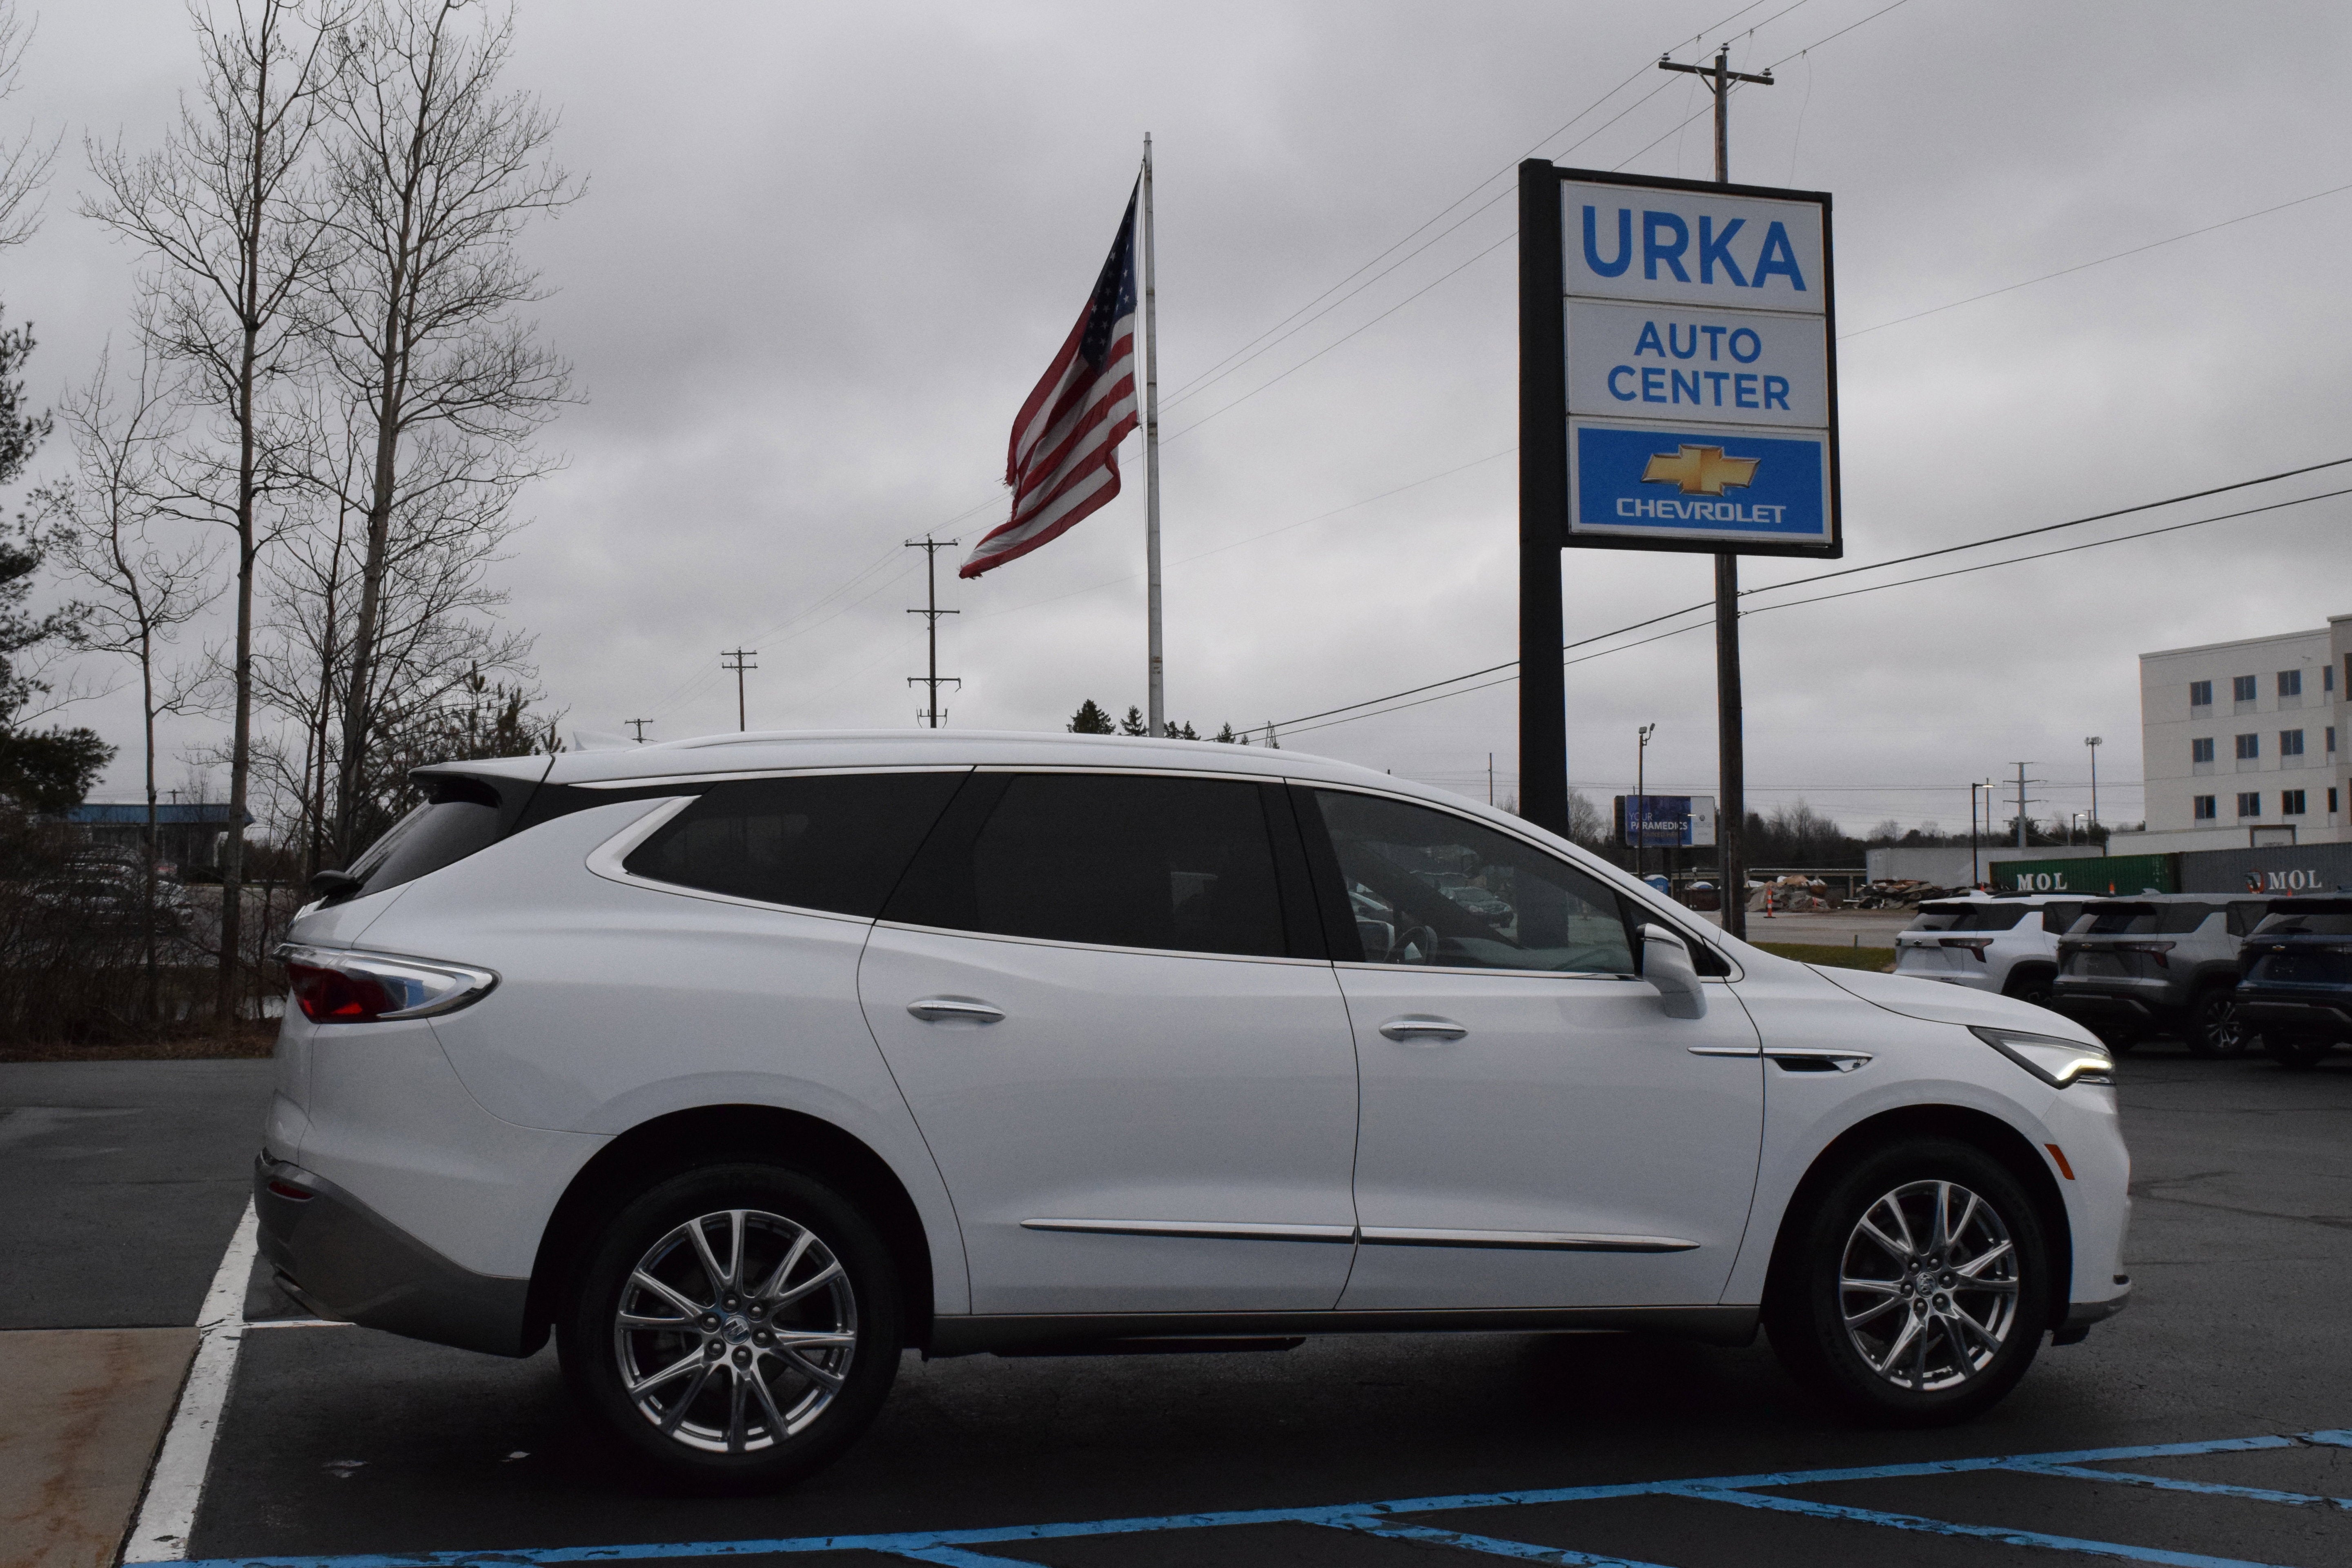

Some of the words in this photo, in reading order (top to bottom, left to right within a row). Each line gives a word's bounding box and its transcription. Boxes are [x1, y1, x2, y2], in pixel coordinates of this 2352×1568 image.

[1582, 205, 1807, 292] URKA
[1634, 321, 1762, 363] AUTO
[1607, 365, 1791, 410] CENTER
[1616, 497, 1786, 523] CHEVROLET
[1628, 812, 1653, 821] YOUR
[2017, 872, 2067, 891] MOL
[2268, 870, 2323, 890] MOL
